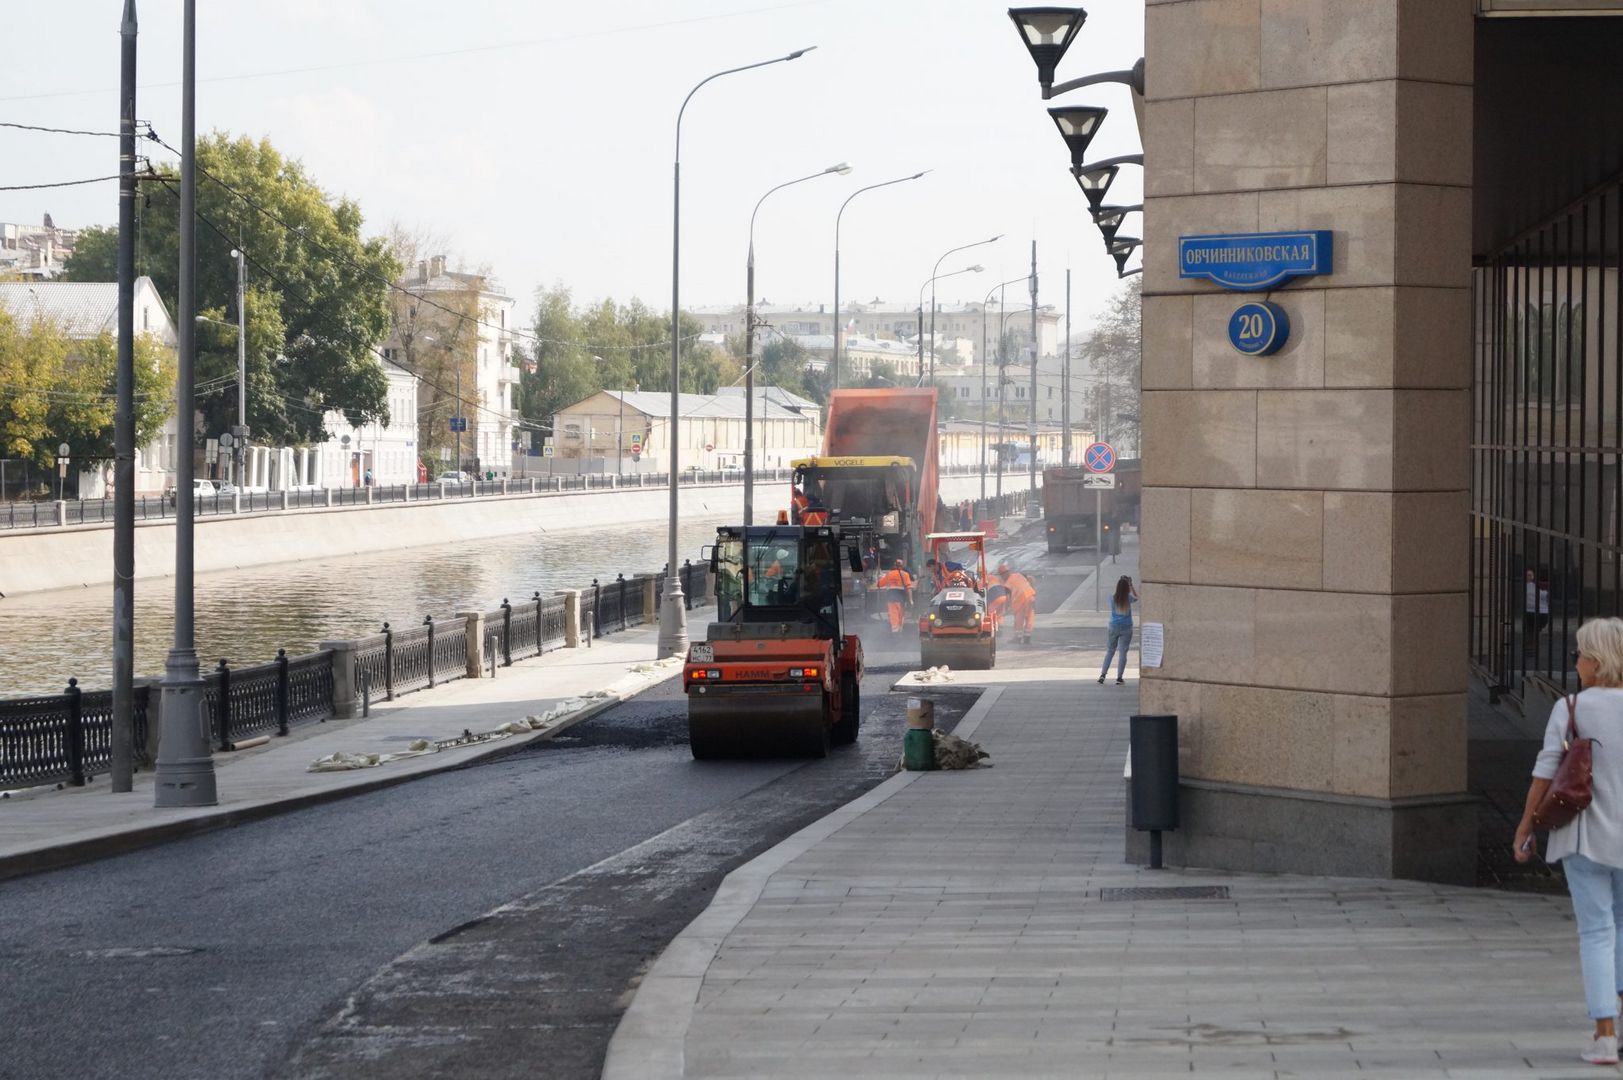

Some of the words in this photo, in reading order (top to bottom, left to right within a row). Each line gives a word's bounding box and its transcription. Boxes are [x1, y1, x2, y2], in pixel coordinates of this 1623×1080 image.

[1186, 244, 1309, 264] ОВЧИННИКОВСКАЯ
[1238, 313, 1263, 339] 20
[735, 670, 769, 679] HAMM
